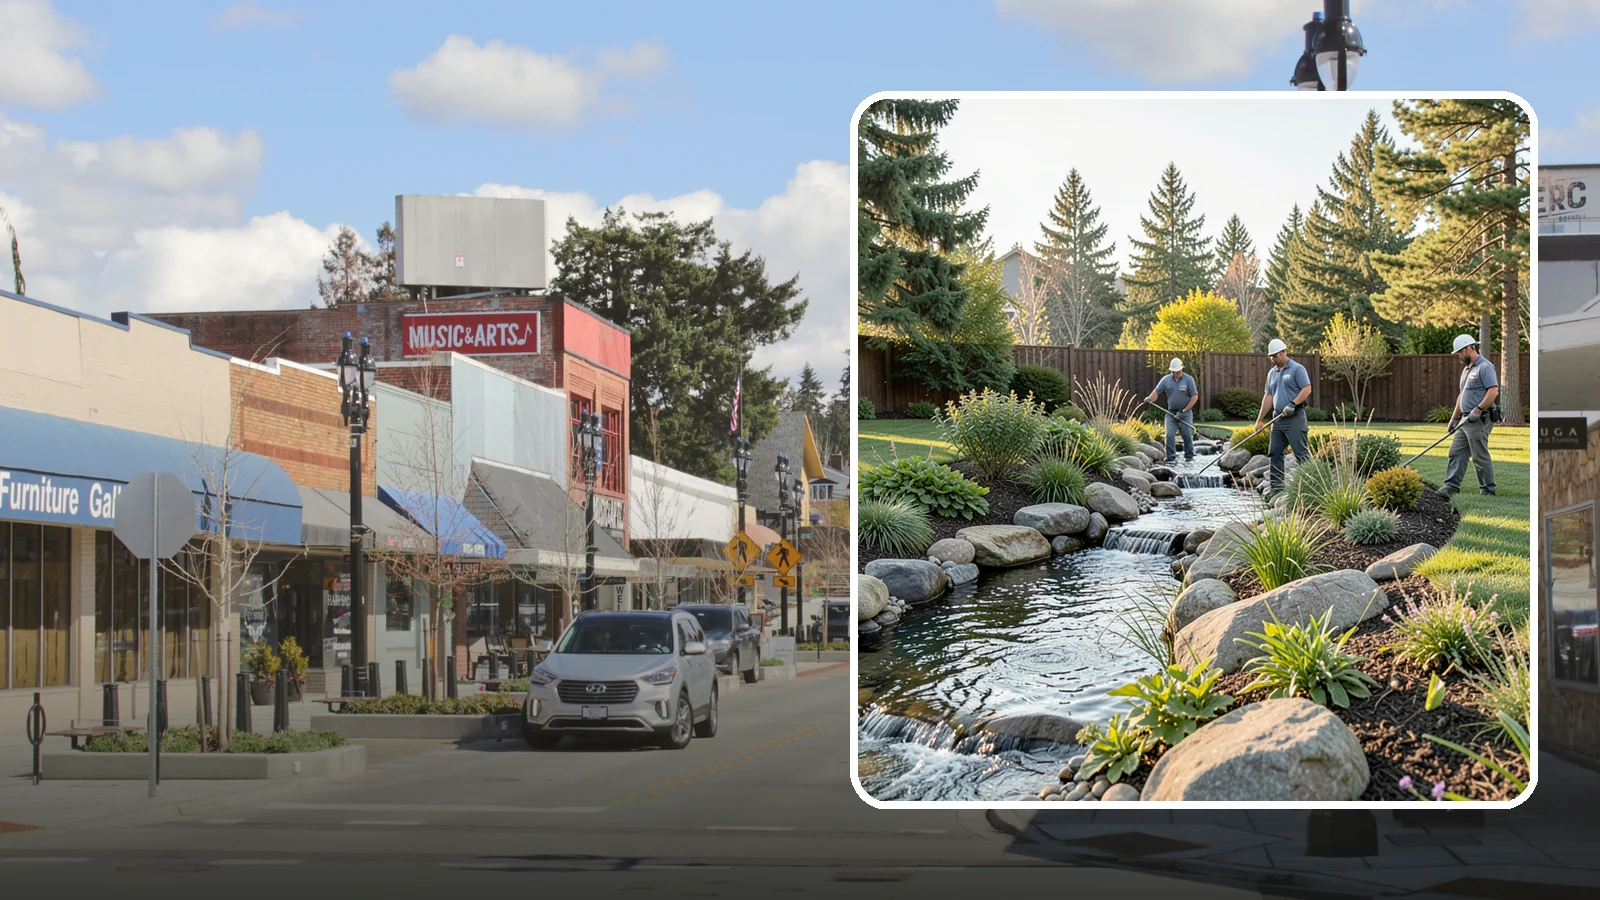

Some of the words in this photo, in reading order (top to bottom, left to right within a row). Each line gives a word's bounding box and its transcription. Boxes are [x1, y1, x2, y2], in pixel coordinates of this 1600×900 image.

[1540, 428, 1577, 436] UGA
[0, 471, 79, 515] Furniture
[454, 563, 479, 574] SUSHI
